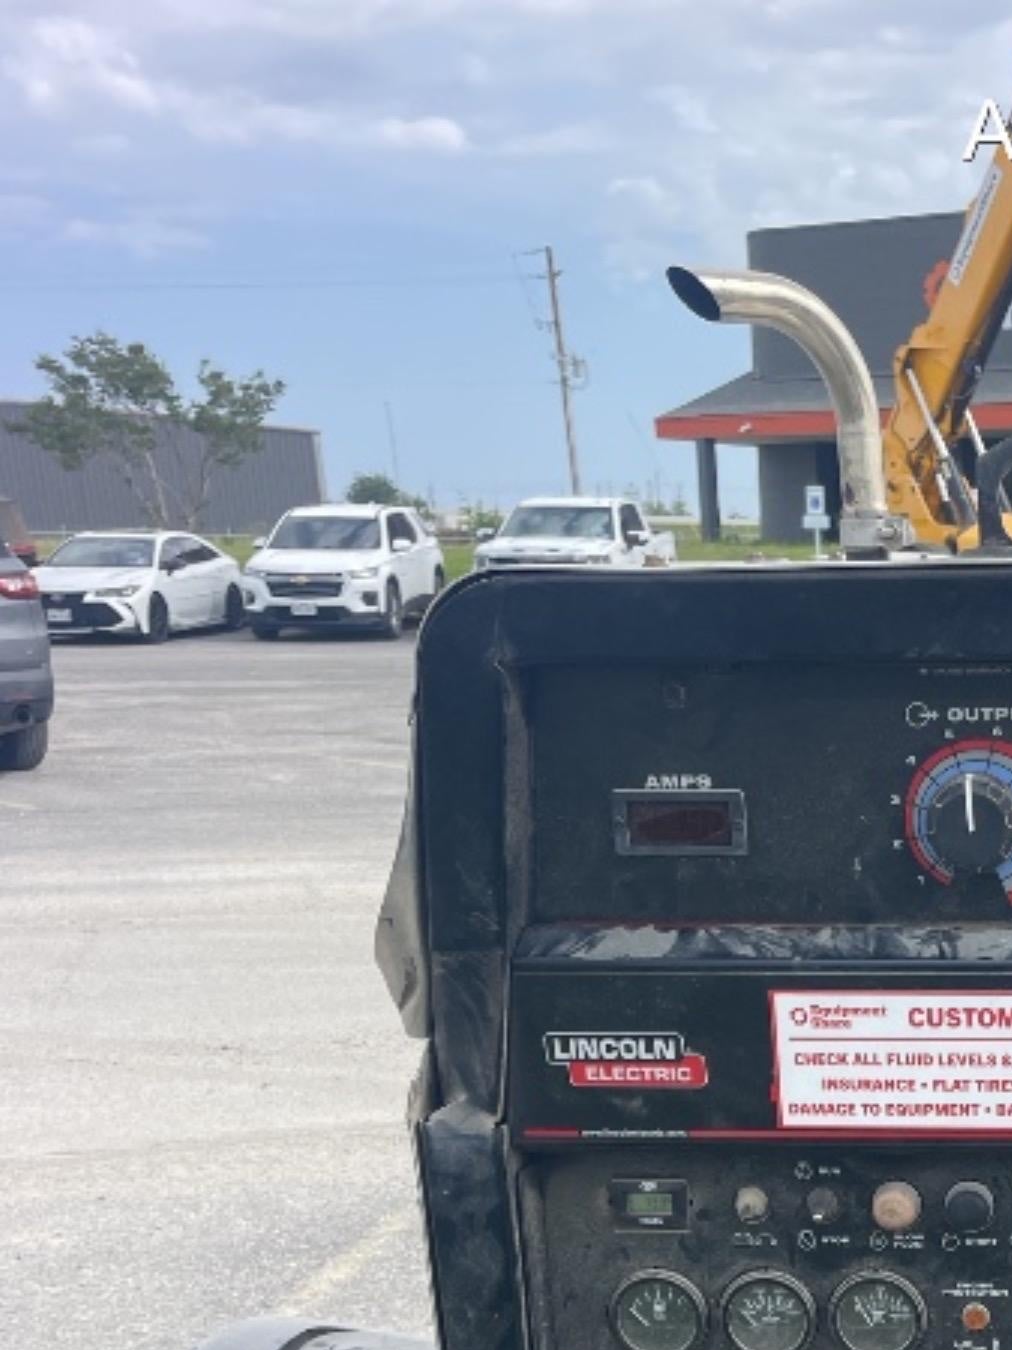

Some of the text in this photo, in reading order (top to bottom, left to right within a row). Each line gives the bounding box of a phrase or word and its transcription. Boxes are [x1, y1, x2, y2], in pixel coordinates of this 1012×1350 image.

[644, 773, 713, 789] AMPS
[552, 1036, 677, 1061] LINCOLN
[793, 1052, 848, 1067] CHECK
[851, 1052, 882, 1067] ALL
[886, 1052, 933, 1067] FLUID
[937, 1053, 997, 1068] LEVELS
[1001, 1054, 1012, 1068] &
[584, 1066, 693, 1082] ELECTRIC
[821, 1078, 917, 1093] INSURANCE
[932, 1078, 972, 1093] FLAT
[788, 1102, 857, 1117] DAMAGE
[861, 1102, 881, 1117] TO
[884, 1102, 980, 1118] EQUIPMENT
